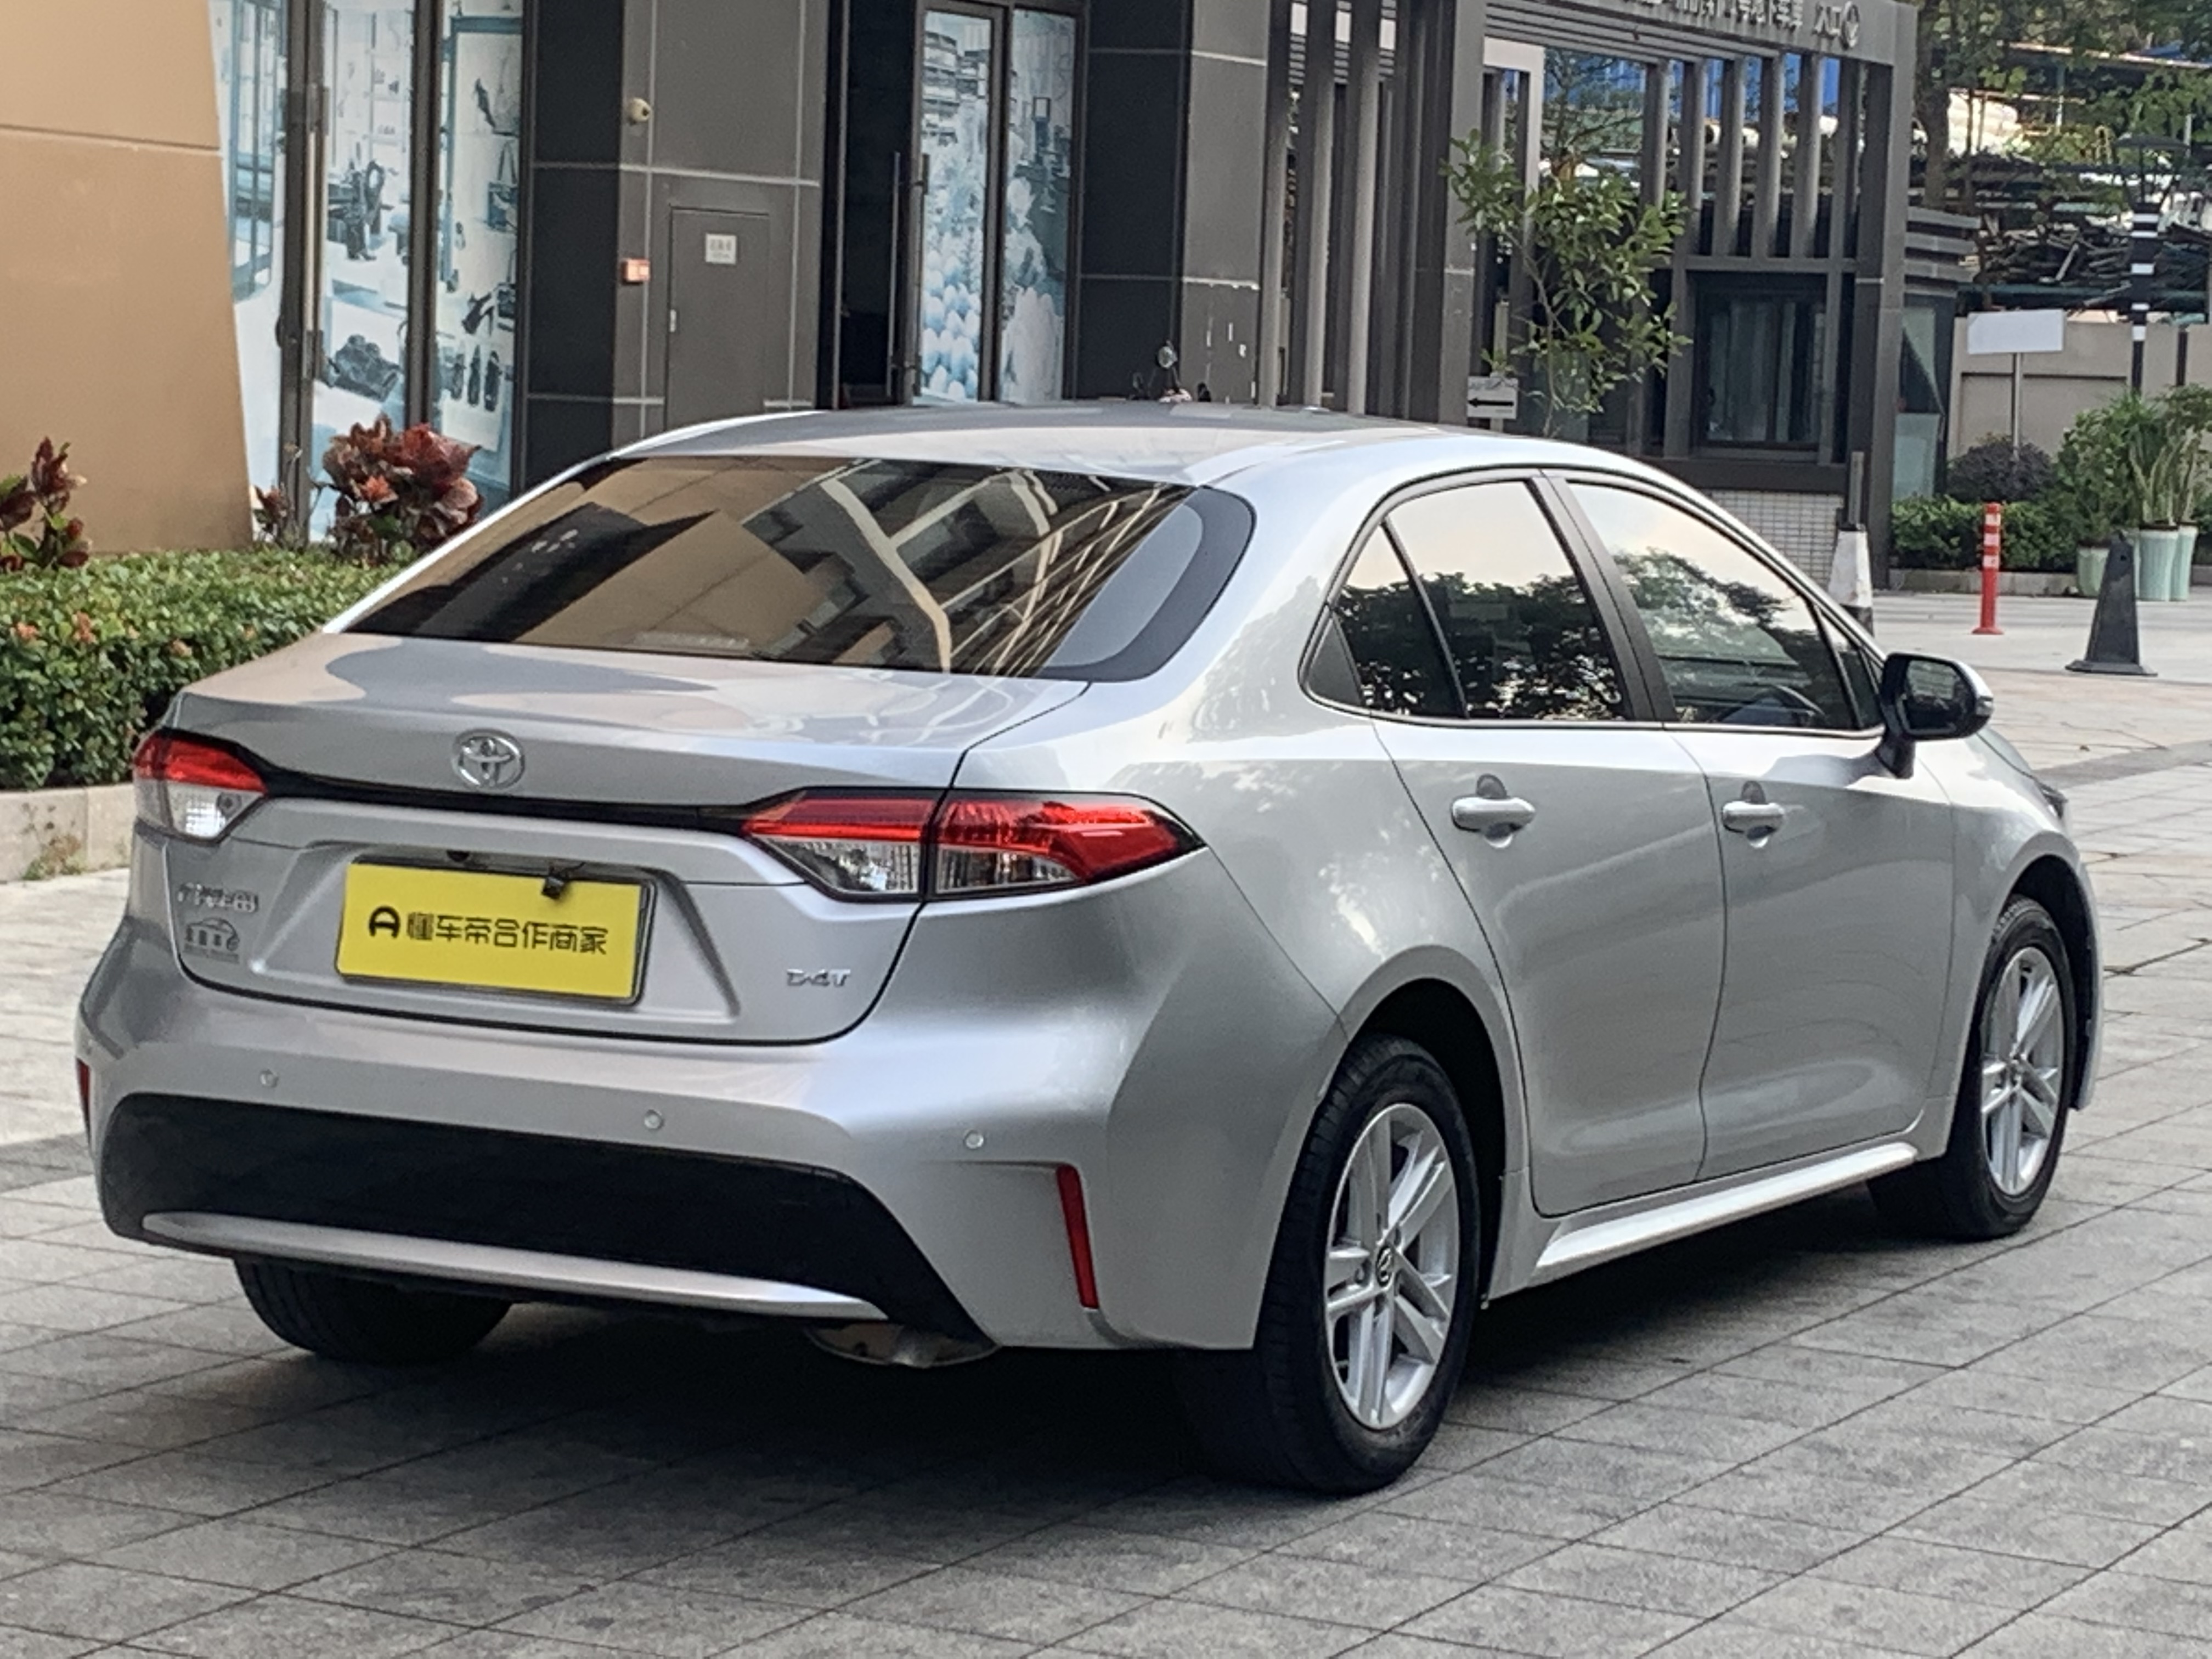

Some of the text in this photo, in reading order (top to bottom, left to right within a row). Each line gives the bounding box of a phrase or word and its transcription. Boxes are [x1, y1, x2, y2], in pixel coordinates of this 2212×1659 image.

[407, 912, 608, 955] 懂车帝合作商家
